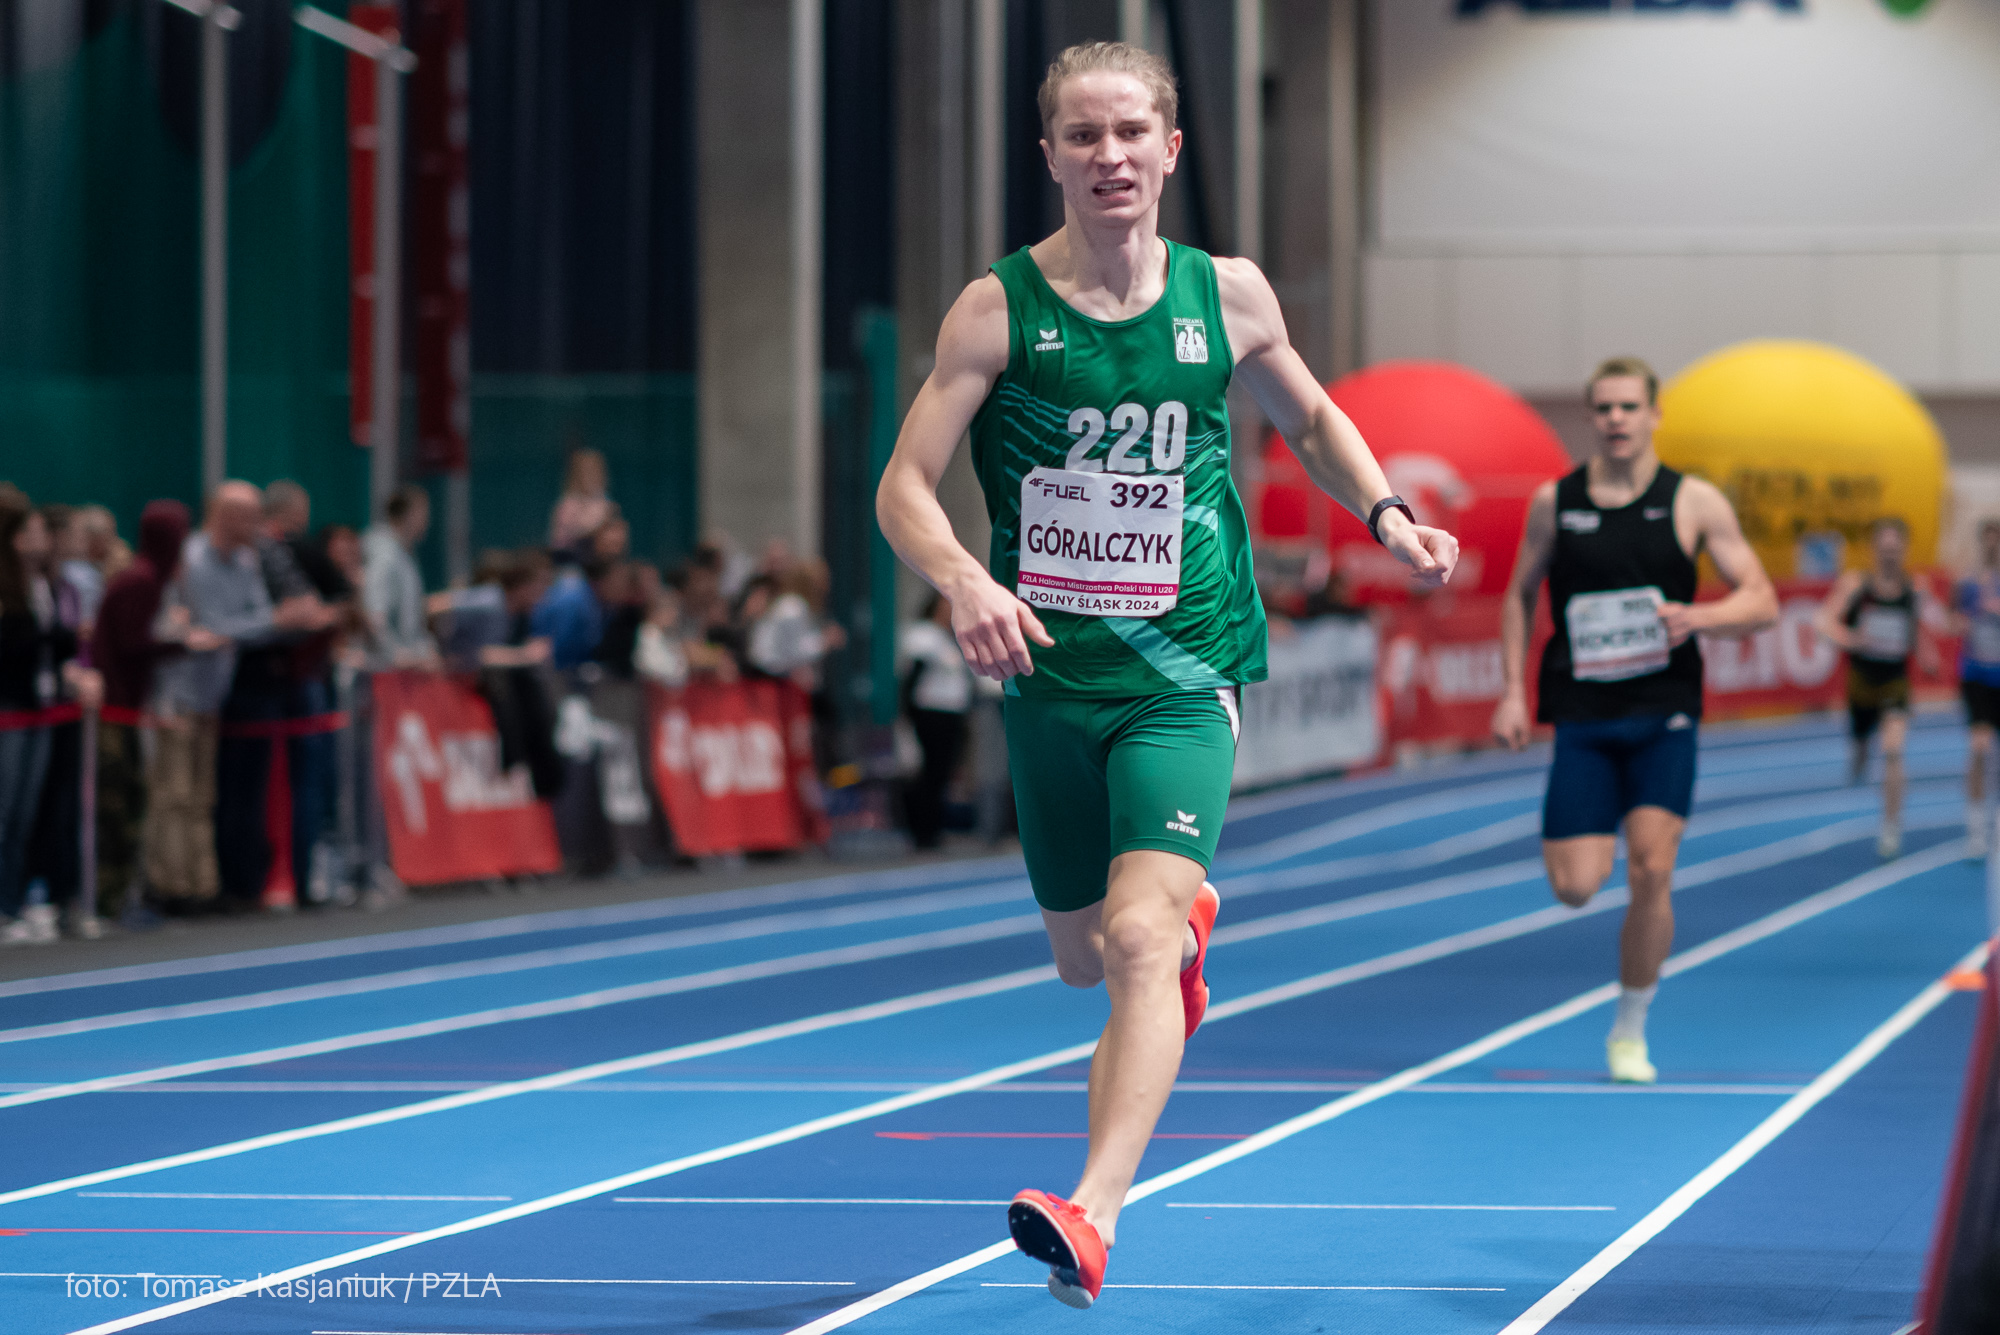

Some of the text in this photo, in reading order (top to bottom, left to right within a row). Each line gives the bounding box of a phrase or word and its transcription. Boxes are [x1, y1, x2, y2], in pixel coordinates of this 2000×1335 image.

[1035, 341, 1065, 351] erima
[1065, 401, 1188, 473] 220
[1043, 483, 1091, 502] FUEL
[1110, 482, 1169, 509] 392
[1027, 520, 1174, 564] GÓRALCZYK
[1022, 574, 1037, 583] PZLA
[1038, 577, 1066, 588] Halowe
[1067, 581, 1113, 592] Mistrzostwa
[1114, 584, 1137, 593] Polski
[1138, 585, 1152, 594] U18
[1158, 586, 1174, 594] U20
[1029, 590, 1160, 611] DOLNY ŚLĄSK 2024
[1165, 821, 1201, 838] erima
